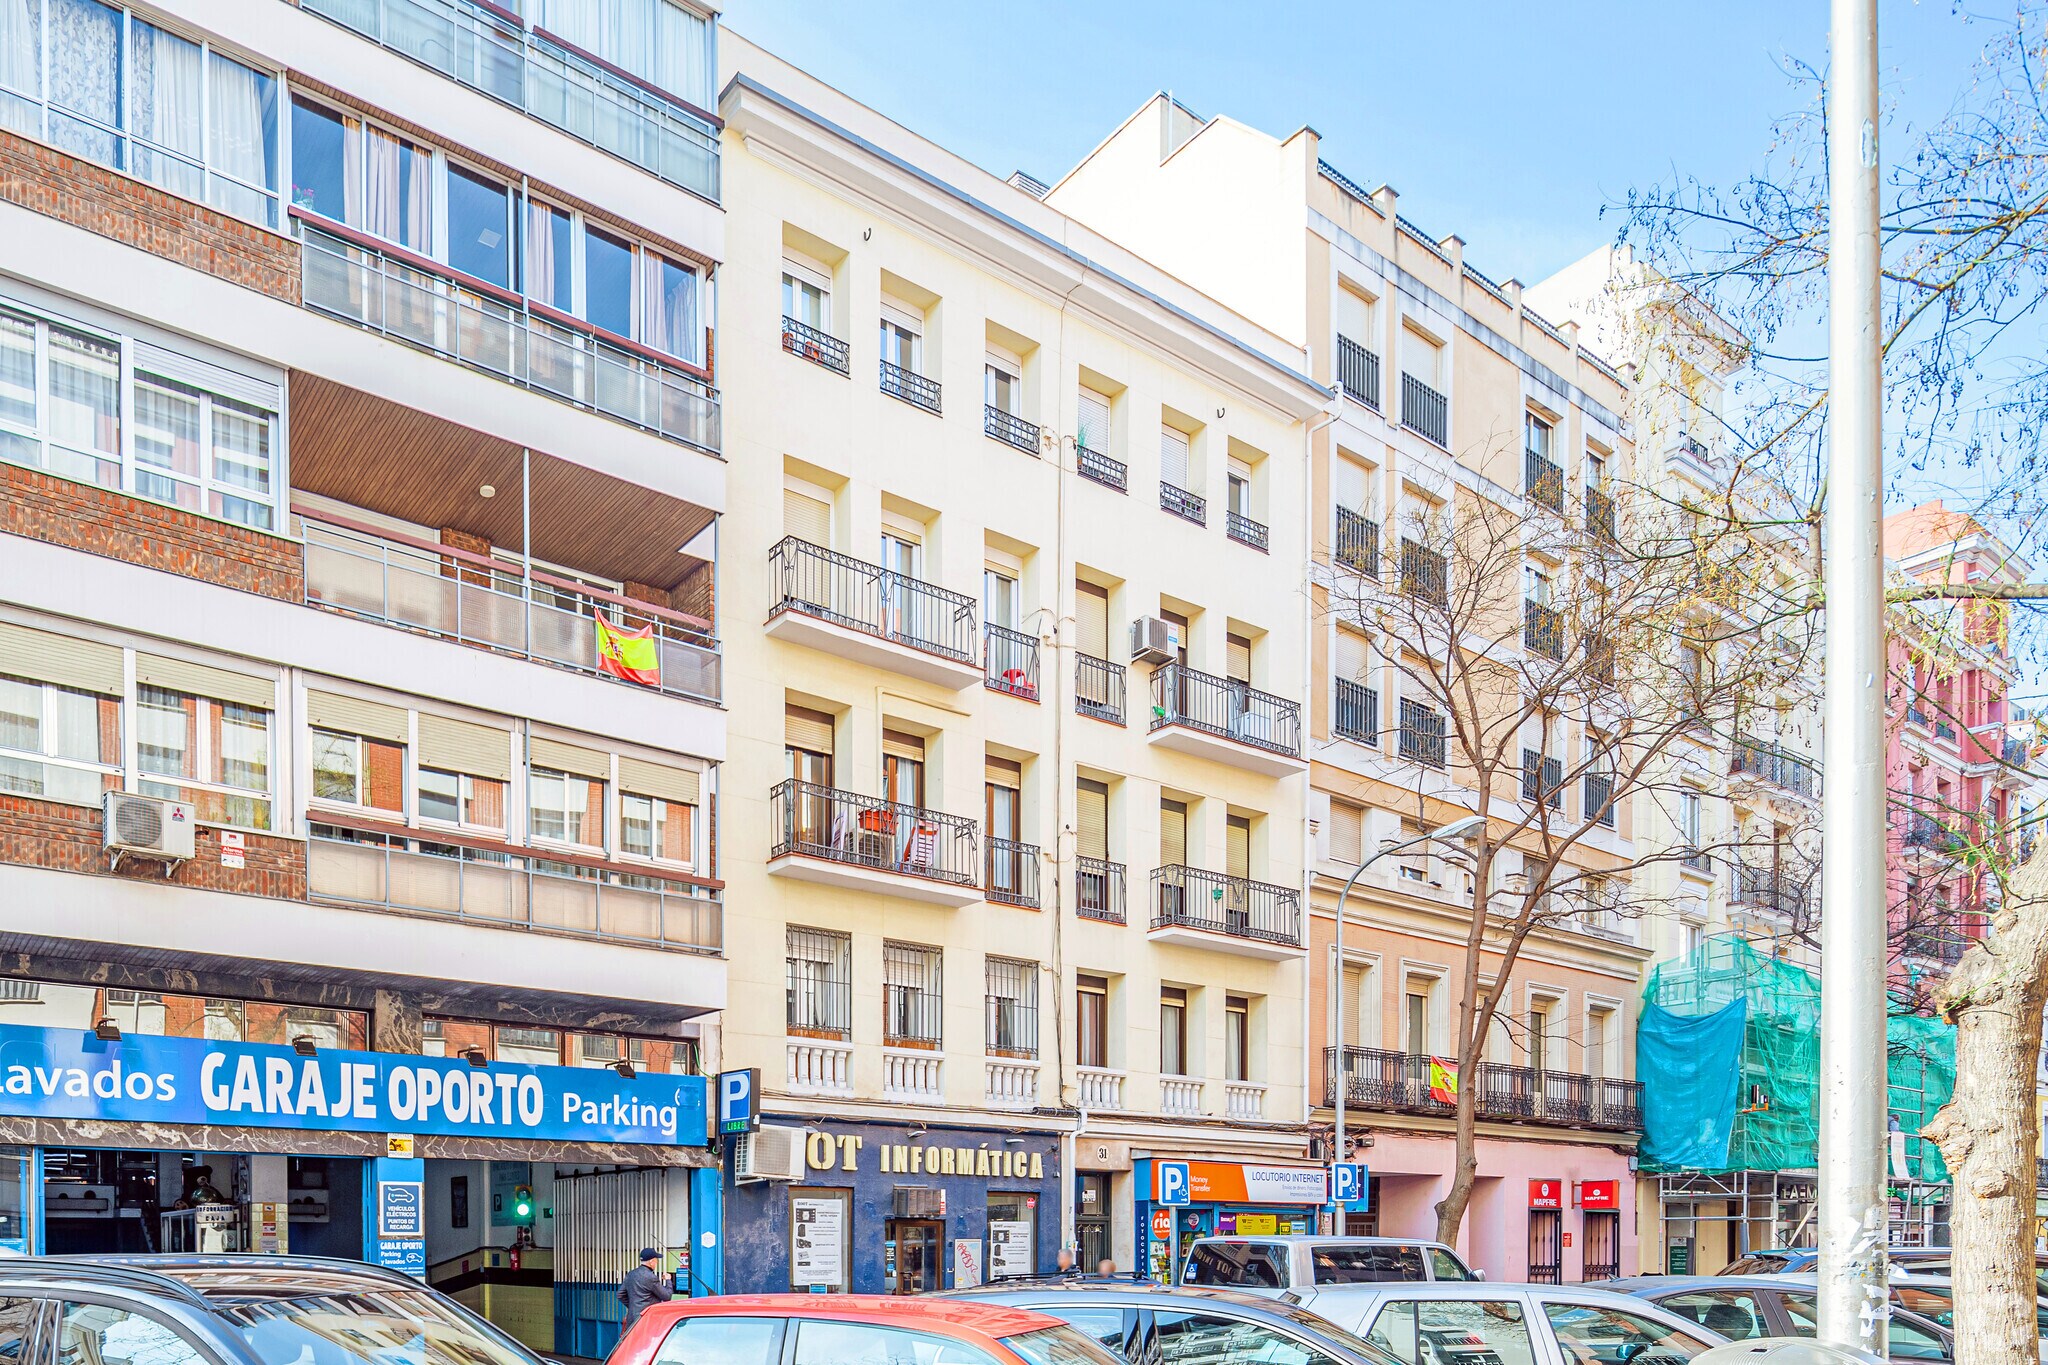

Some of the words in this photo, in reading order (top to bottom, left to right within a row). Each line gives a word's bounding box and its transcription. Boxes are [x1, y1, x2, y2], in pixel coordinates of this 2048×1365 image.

[0, 1059, 176, 1102] avados
[200, 1052, 377, 1119] GARAJE
[388, 1066, 544, 1127] OPORTO
[721, 1073, 750, 1120] P
[563, 1092, 678, 1136] Parking
[727, 1121, 745, 1131] LIBRE
[880, 1142, 1044, 1179] INFORMÁTICA
[1099, 1148, 1108, 1160] 31
[1165, 1167, 1183, 1201] P
[1190, 1175, 1209, 1184] Money
[1251, 1171, 1291, 1183] LOCUTORIO
[1292, 1172, 1324, 1184] INTERNET
[1337, 1167, 1352, 1197] P
[1190, 1184, 1211, 1193] Transfer
[1533, 1198, 1557, 1206] MAPFRE
[1154, 1212, 1170, 1229] ria
[380, 1241, 401, 1250] GARAJE
[402, 1241, 423, 1250] OPORTO
